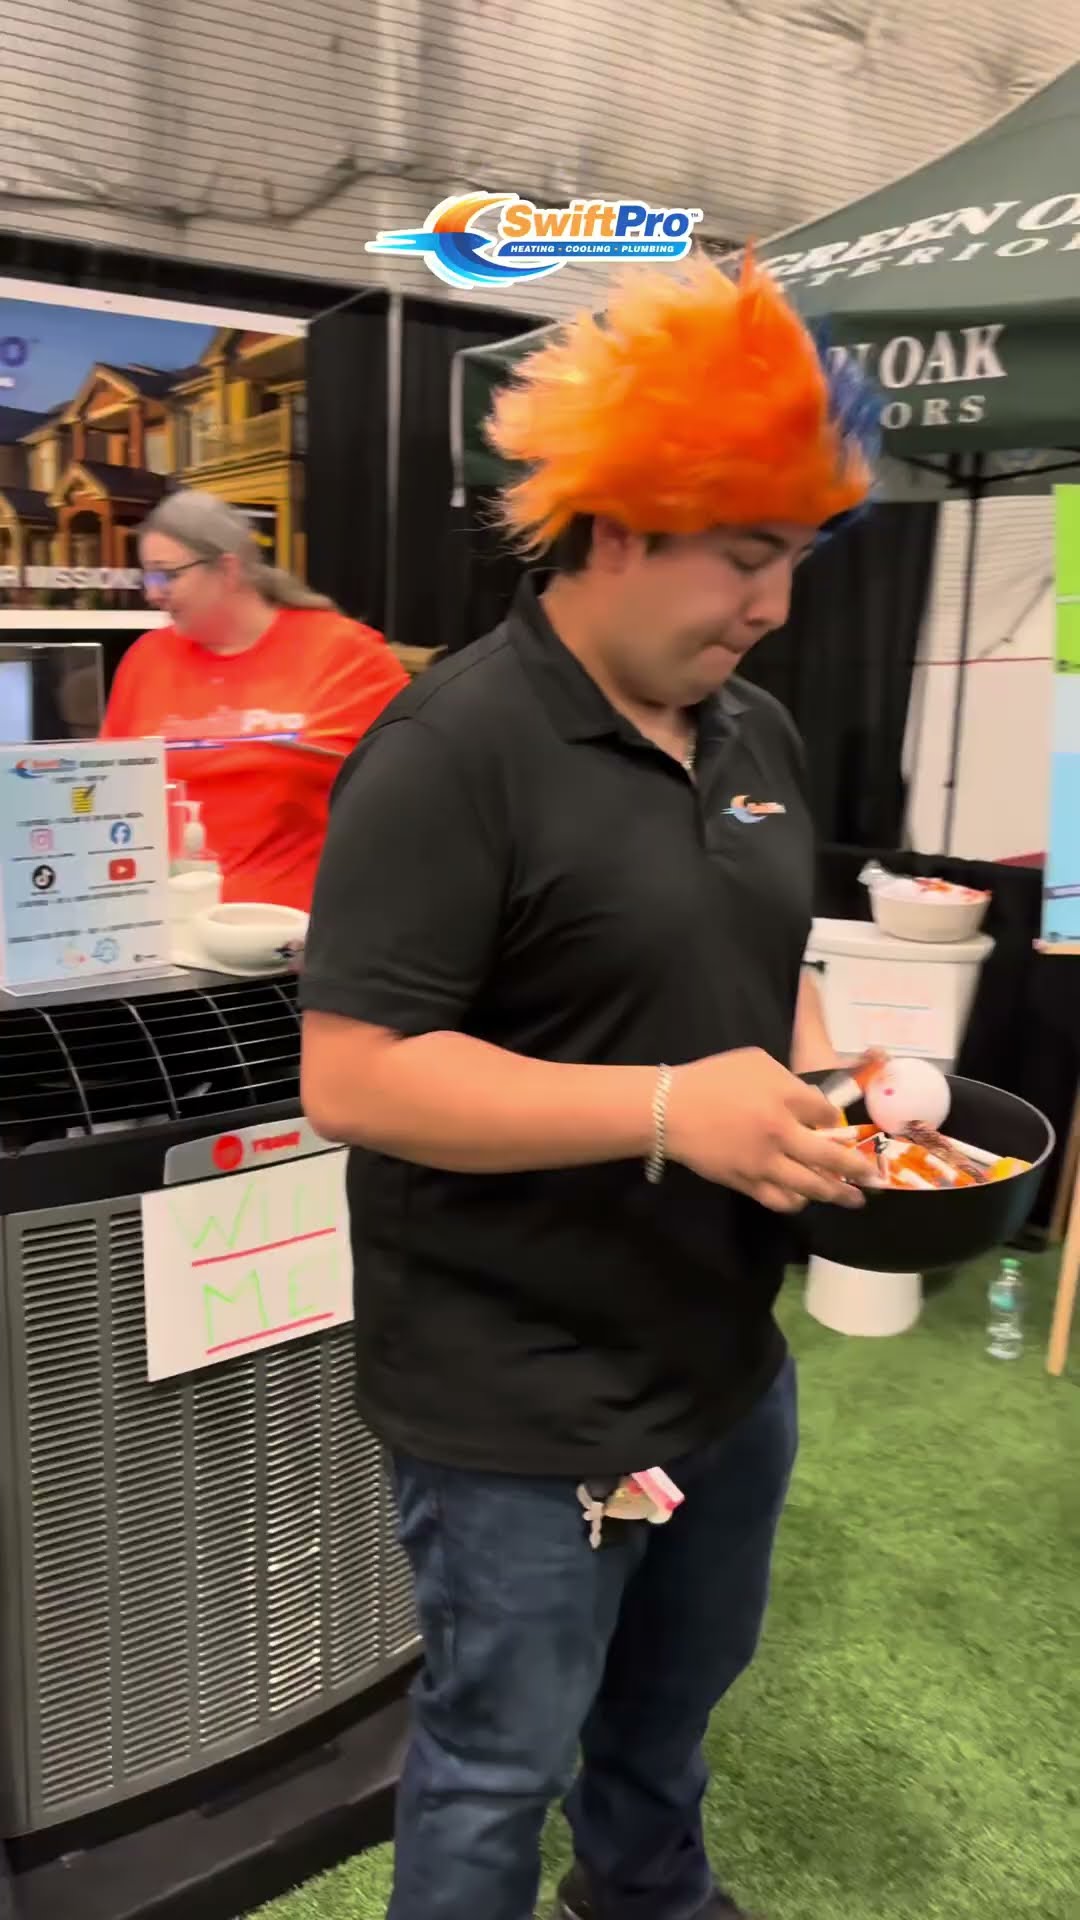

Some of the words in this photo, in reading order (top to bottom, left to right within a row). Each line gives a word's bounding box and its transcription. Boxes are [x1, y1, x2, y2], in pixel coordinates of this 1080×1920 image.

[754, 200, 1022, 276] GREEN
[1016, 193, 1080, 230] O
[879, 324, 1008, 389] OAK
